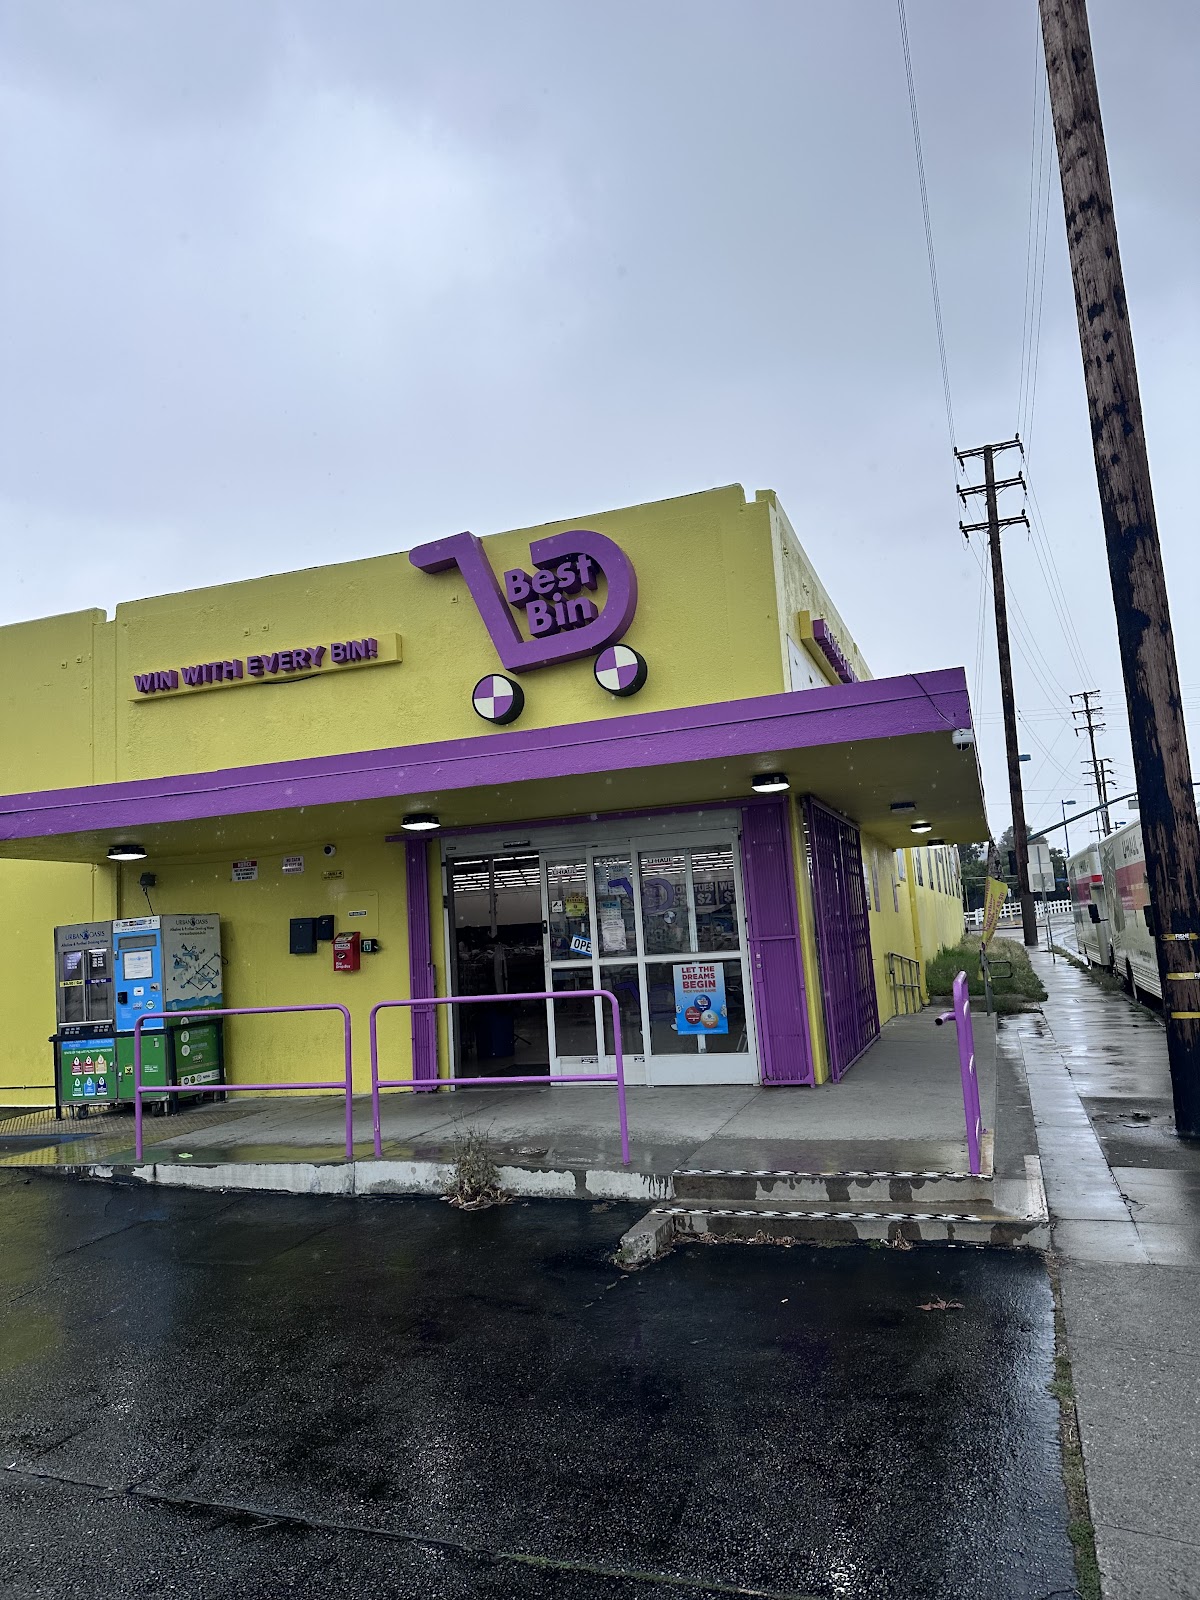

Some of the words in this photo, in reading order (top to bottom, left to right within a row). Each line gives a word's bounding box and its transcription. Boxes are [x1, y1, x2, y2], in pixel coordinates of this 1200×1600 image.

[504, 554, 595, 606] Best
[526, 592, 597, 637] Bin
[134, 670, 178, 694] WIN
[181, 659, 243, 686] WITH
[247, 645, 326, 677] EVERY
[331, 637, 378, 664] BIN!
[694, 884, 714, 892] TUES
[720, 881, 735, 890] WE
[697, 893, 712, 904] $2
[65, 932, 83, 940] URBAN
[574, 939, 592, 953] OPE
[682, 980, 716, 989] BEGIN
